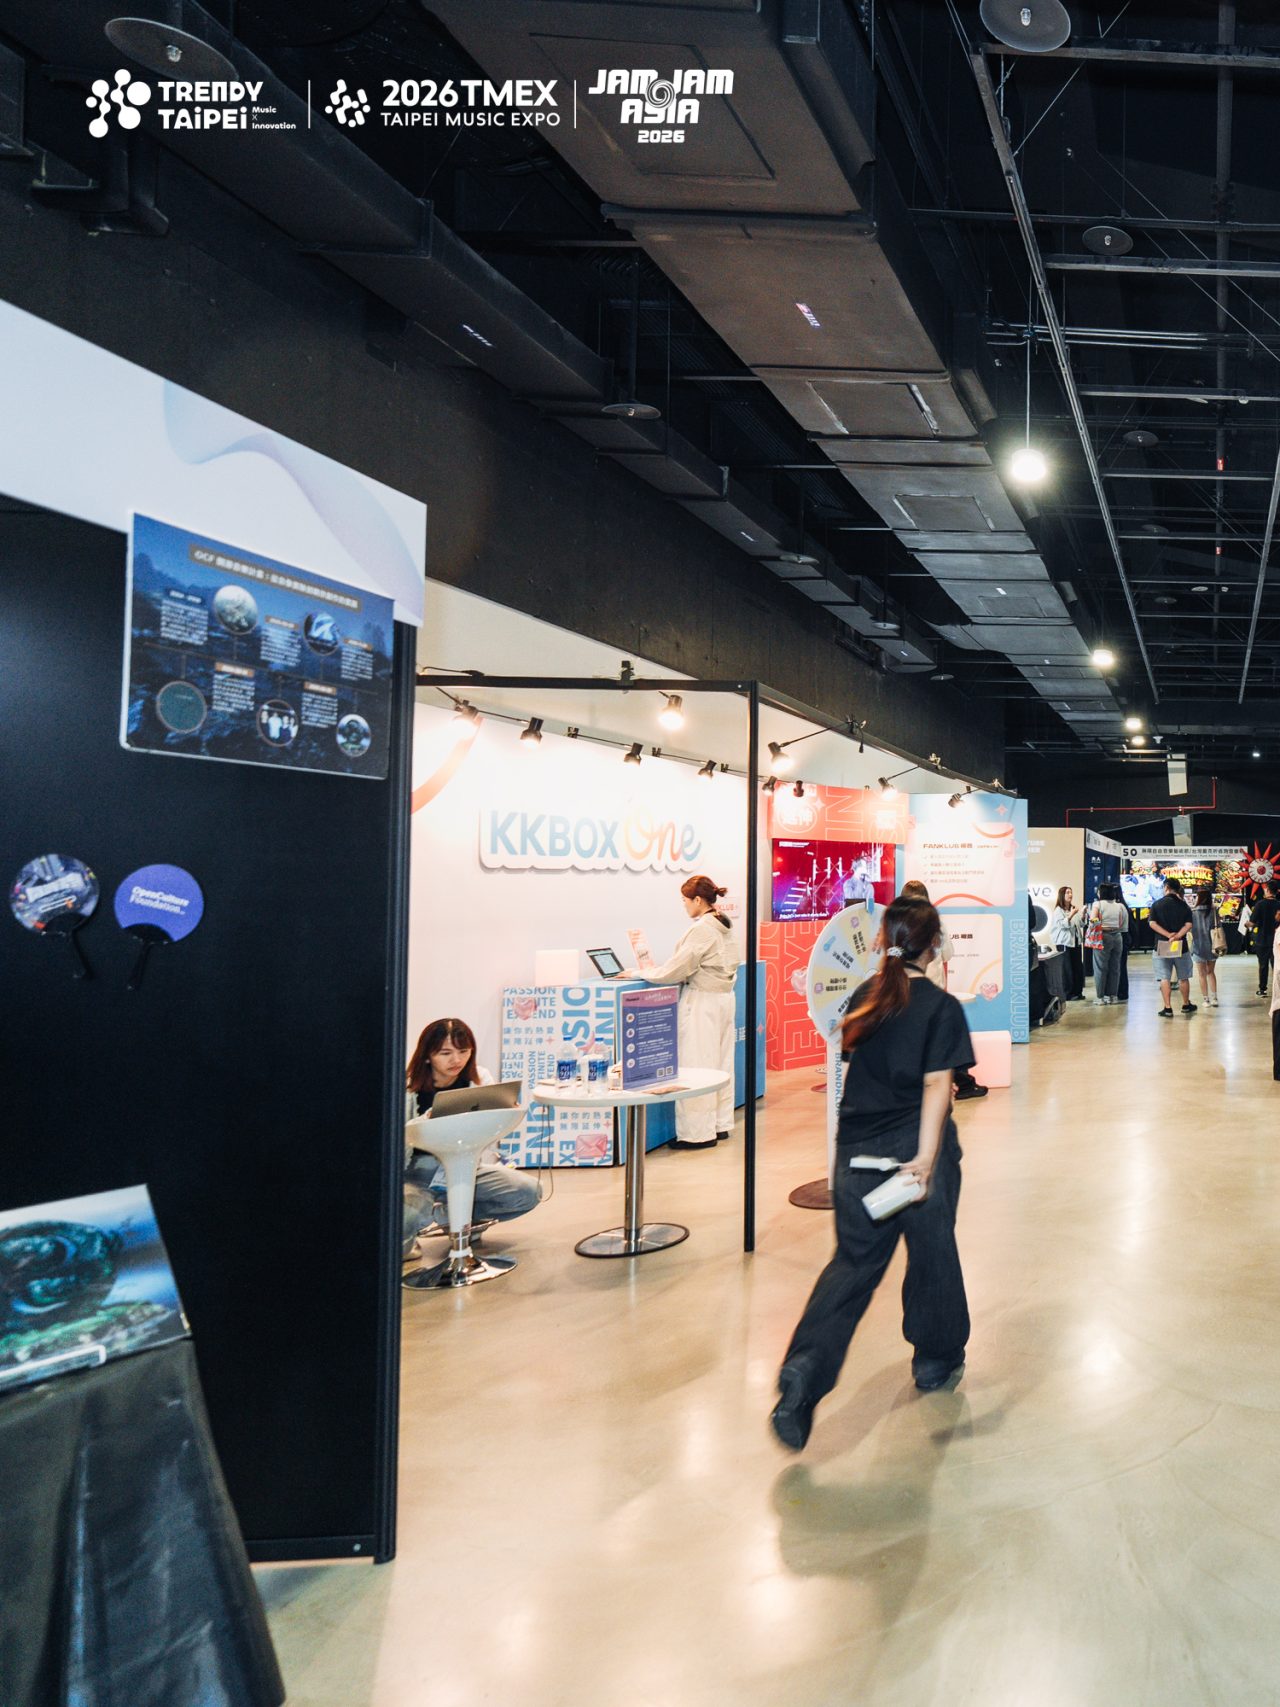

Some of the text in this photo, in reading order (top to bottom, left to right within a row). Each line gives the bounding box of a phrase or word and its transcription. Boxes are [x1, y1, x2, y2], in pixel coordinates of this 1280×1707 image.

[490, 804, 702, 862] KKBOX One
[1123, 848, 1137, 857] 50
[1010, 919, 1028, 1041] BRANDKLUB
